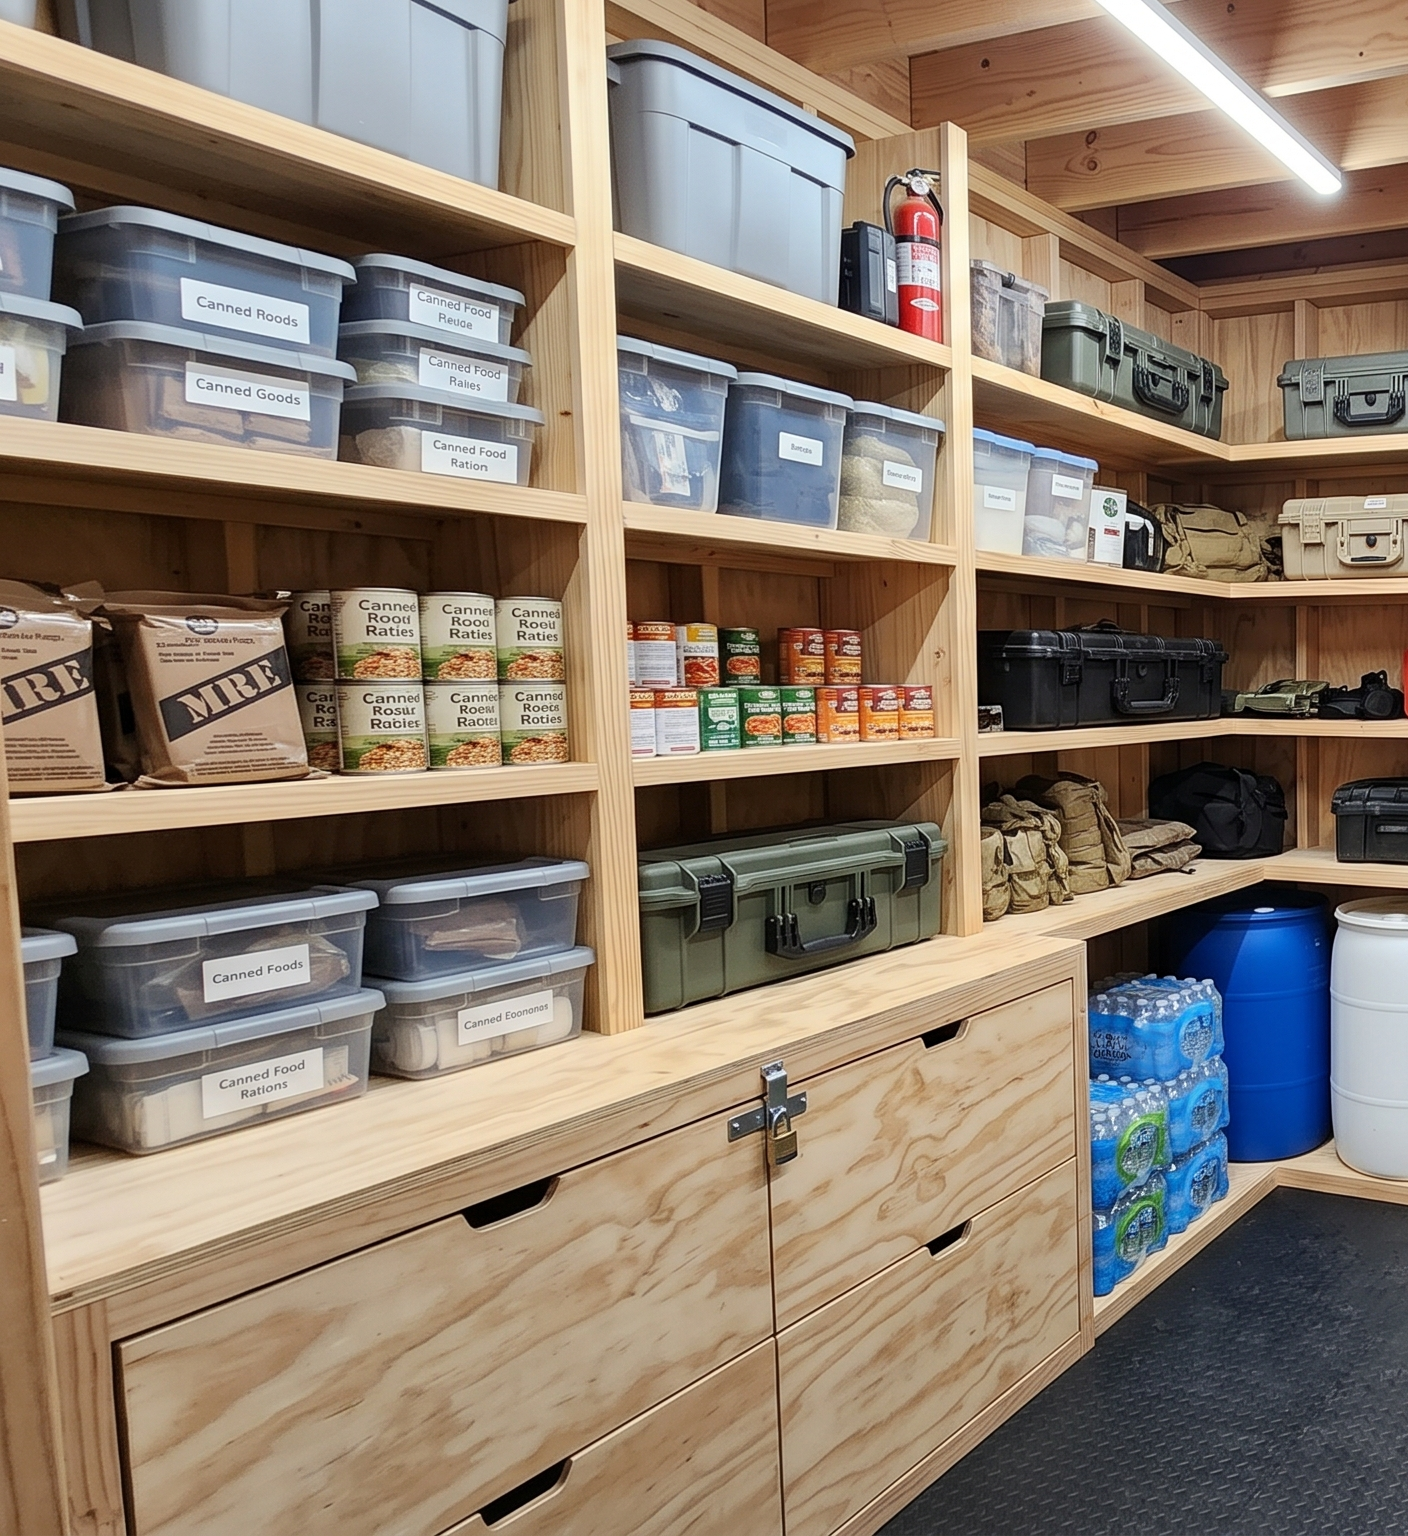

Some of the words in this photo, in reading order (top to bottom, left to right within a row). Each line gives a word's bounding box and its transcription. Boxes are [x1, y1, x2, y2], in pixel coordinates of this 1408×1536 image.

[196, 296, 252, 317] Canned
[256, 308, 298, 327] Roods
[417, 291, 461, 311] Canned
[464, 303, 491, 319] Food
[428, 355, 471, 374] Canned
[474, 365, 501, 380] Food
[196, 378, 252, 397] Canned
[256, 388, 301, 405] Goods
[433, 439, 476, 455] Canned
[479, 447, 507, 459] Food
[450, 458, 488, 472] Ration
[176, 659, 283, 724] MRE
[212, 966, 263, 984] Canned
[267, 960, 304, 975] Foods
[464, 1013, 502, 1030] Canned
[219, 1068, 270, 1090] Canned
[274, 1059, 306, 1077] Food
[240, 1080, 288, 1100] Rations
